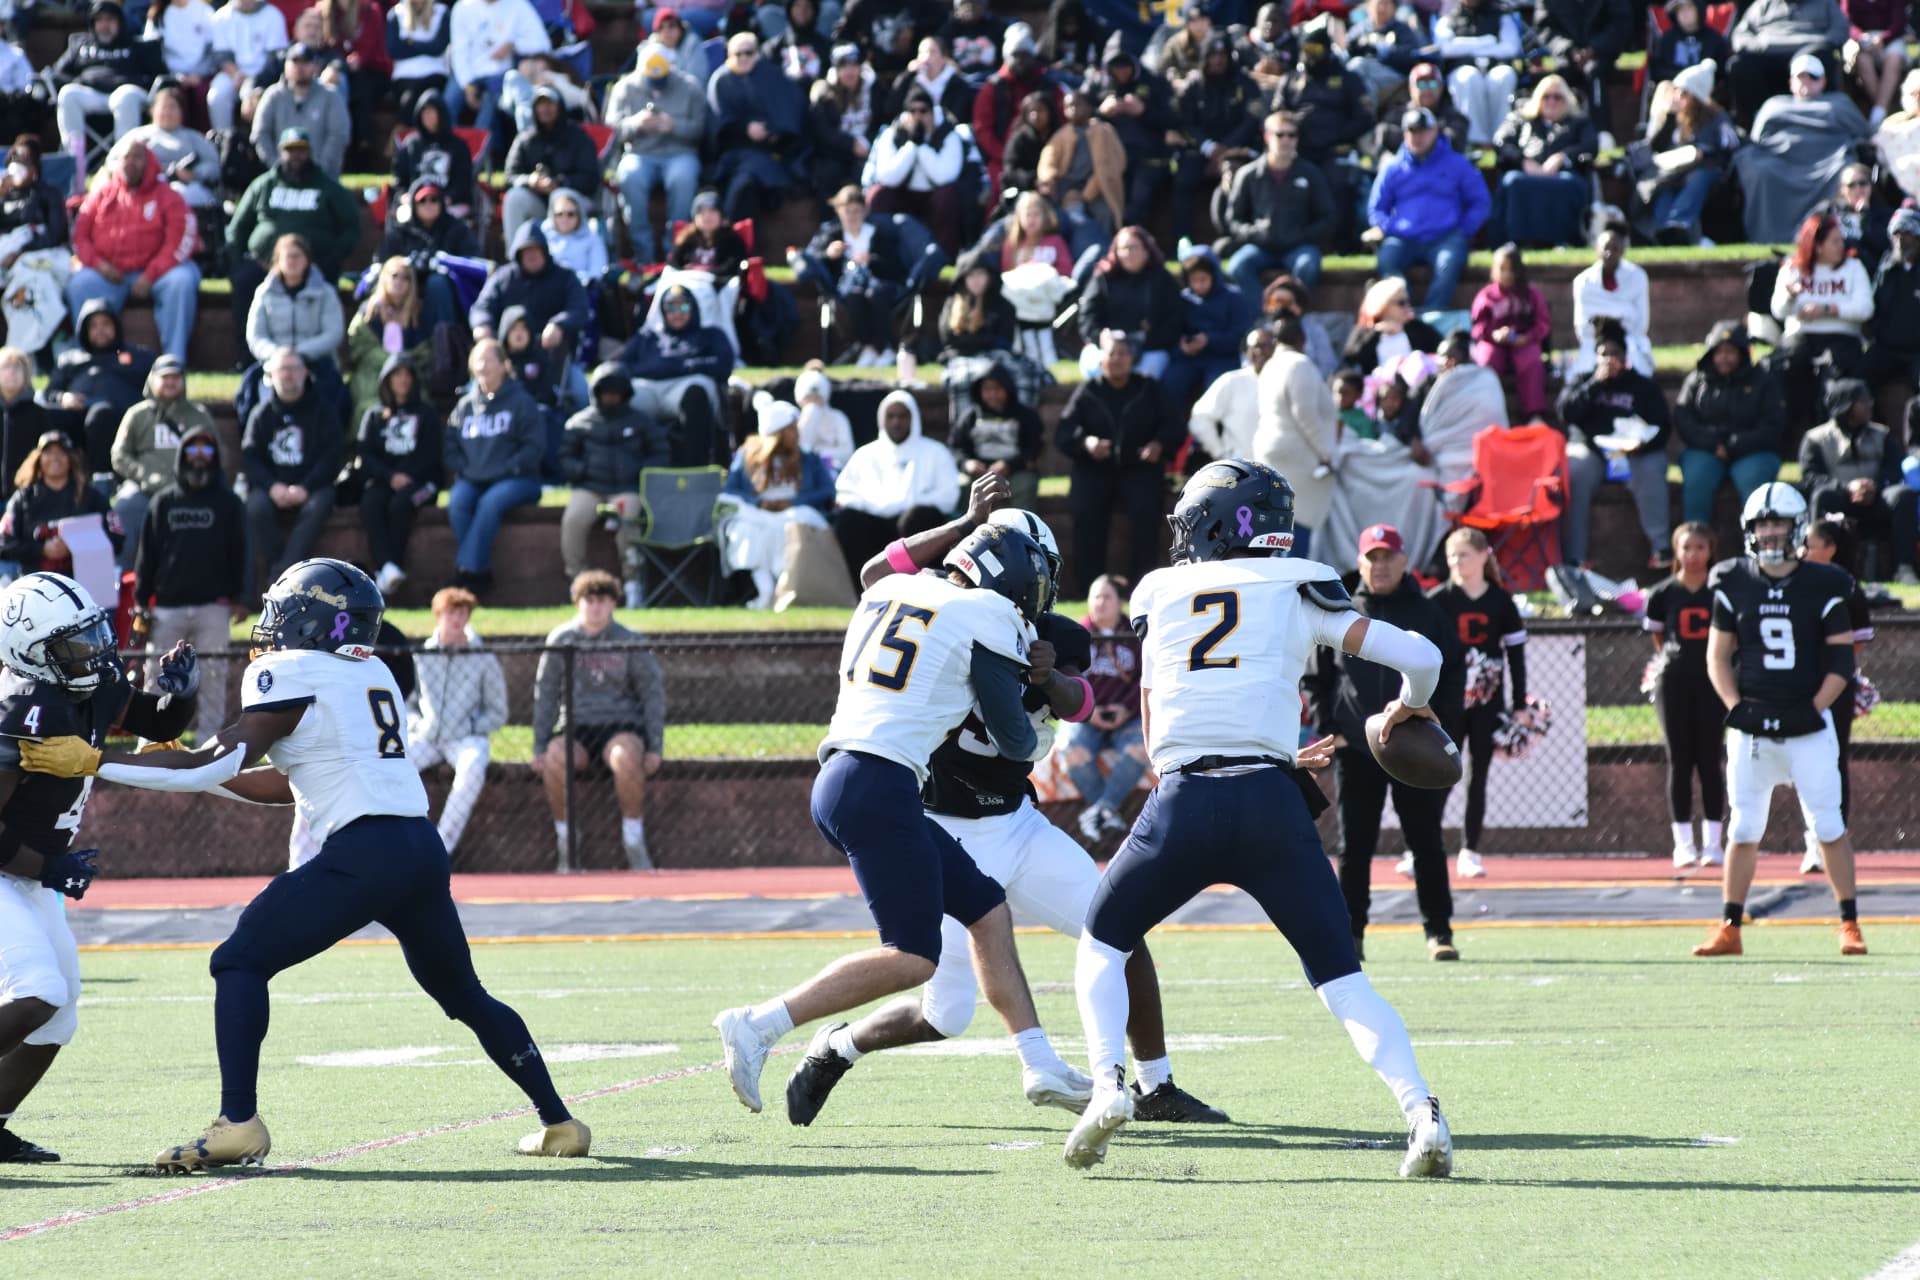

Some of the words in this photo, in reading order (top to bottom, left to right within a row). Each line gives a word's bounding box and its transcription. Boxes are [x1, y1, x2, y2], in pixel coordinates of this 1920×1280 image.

[846, 599, 938, 693] 75
[1187, 589, 1241, 672] 2
[1457, 612, 1489, 644] C
[1679, 607, 1711, 640] C
[1760, 617, 1796, 670] 9
[24, 705, 43, 735] 4
[366, 687, 406, 759] 8
